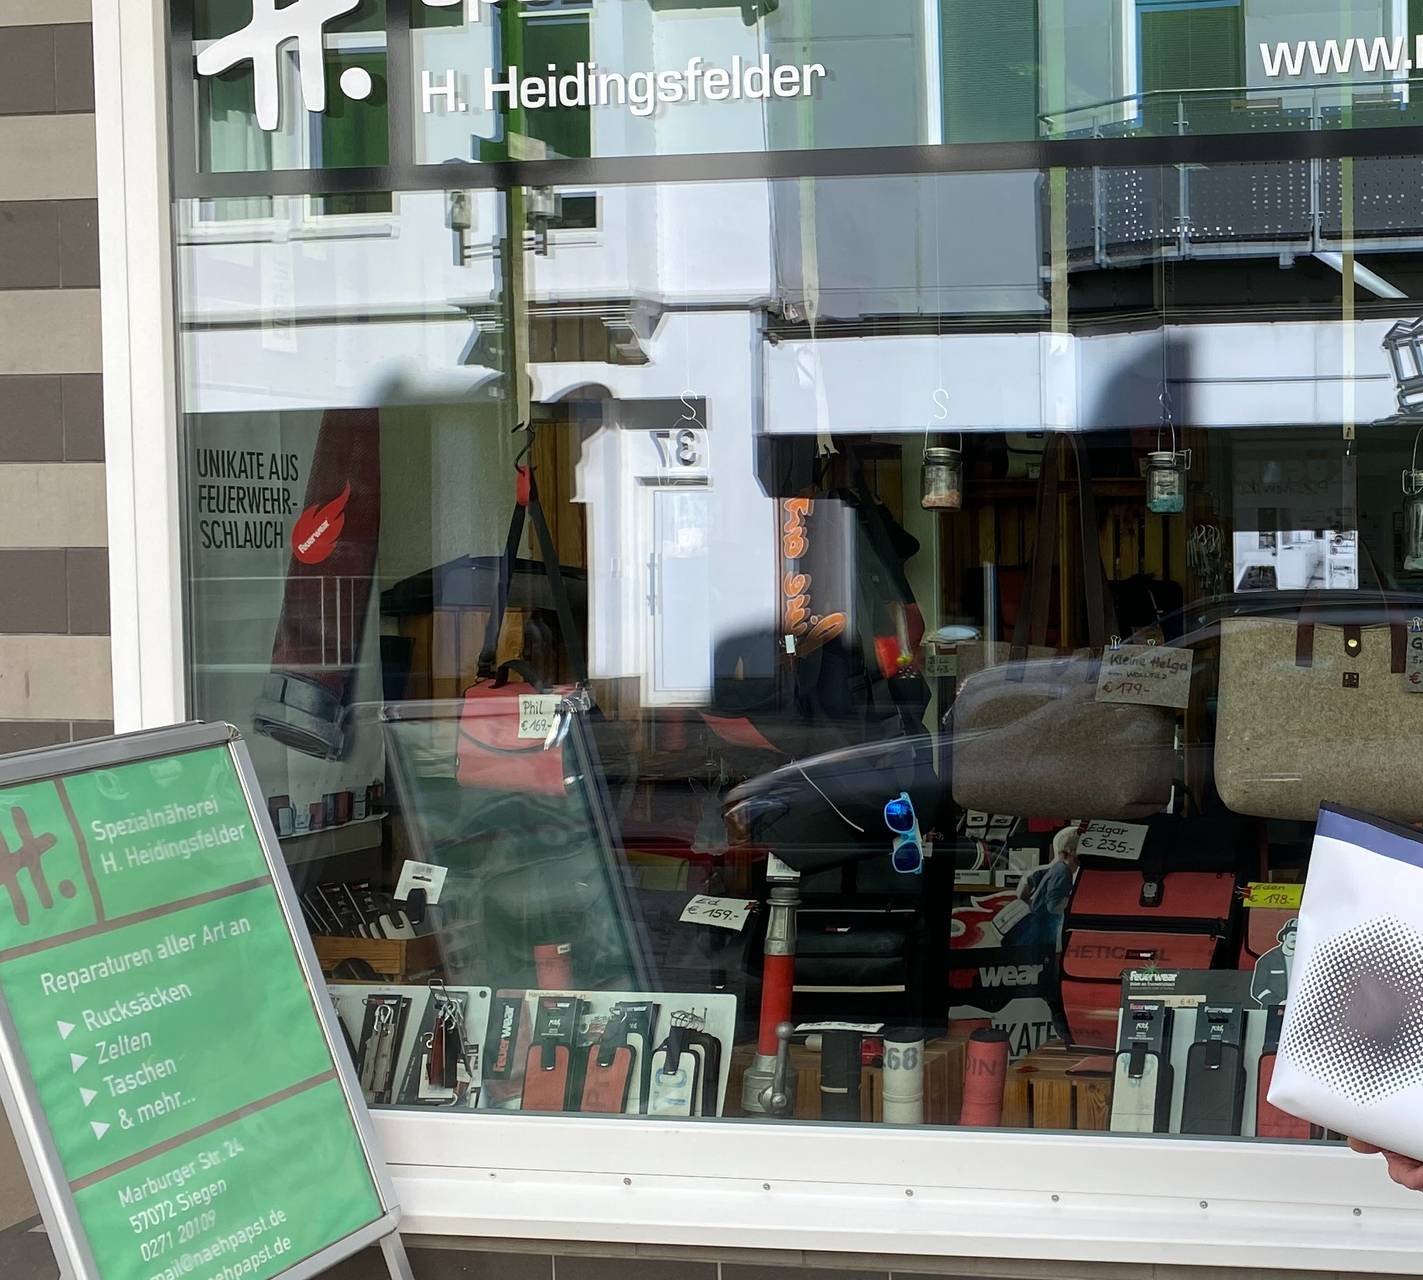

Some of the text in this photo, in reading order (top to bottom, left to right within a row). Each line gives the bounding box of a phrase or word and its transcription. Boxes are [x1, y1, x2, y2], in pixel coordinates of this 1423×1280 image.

[421, 54, 826, 117] H. Heidingsfelder
[197, 449, 298, 481] UNIKATE AUS
[199, 485, 298, 514] FEUERWEHR-
[201, 520, 284, 549] SCHLAUCH
[1150, 656, 1188, 674] Helga
[1409, 671, 1422, 684] €
[1102, 681, 1112, 693] €
[523, 700, 543, 715] Phil
[521, 720, 528, 731] €
[91, 794, 220, 844] Spezialnäherei
[1088, 823, 1128, 838] Edgar
[100, 823, 246, 874] H. Heidingsfelder
[1081, 837, 1136, 854] € 235.-
[688, 905, 740, 921] € 159.-
[695, 898, 721, 906] Ed
[40, 917, 252, 996] Reparaturen aller Art an
[1130, 970, 1178, 982] feuerwear
[81, 981, 193, 1032] Rucksäcken
[95, 1031, 152, 1065] Zelten
[493, 1005, 515, 1073] feuerwear
[102, 1058, 178, 1098] Taschen
[117, 1090, 196, 1130] & mehr...
[117, 1138, 245, 1208] Marburger Str. 24
[128, 1178, 228, 1234] 57072 Siegen
[140, 1231, 174, 1262] 0271
